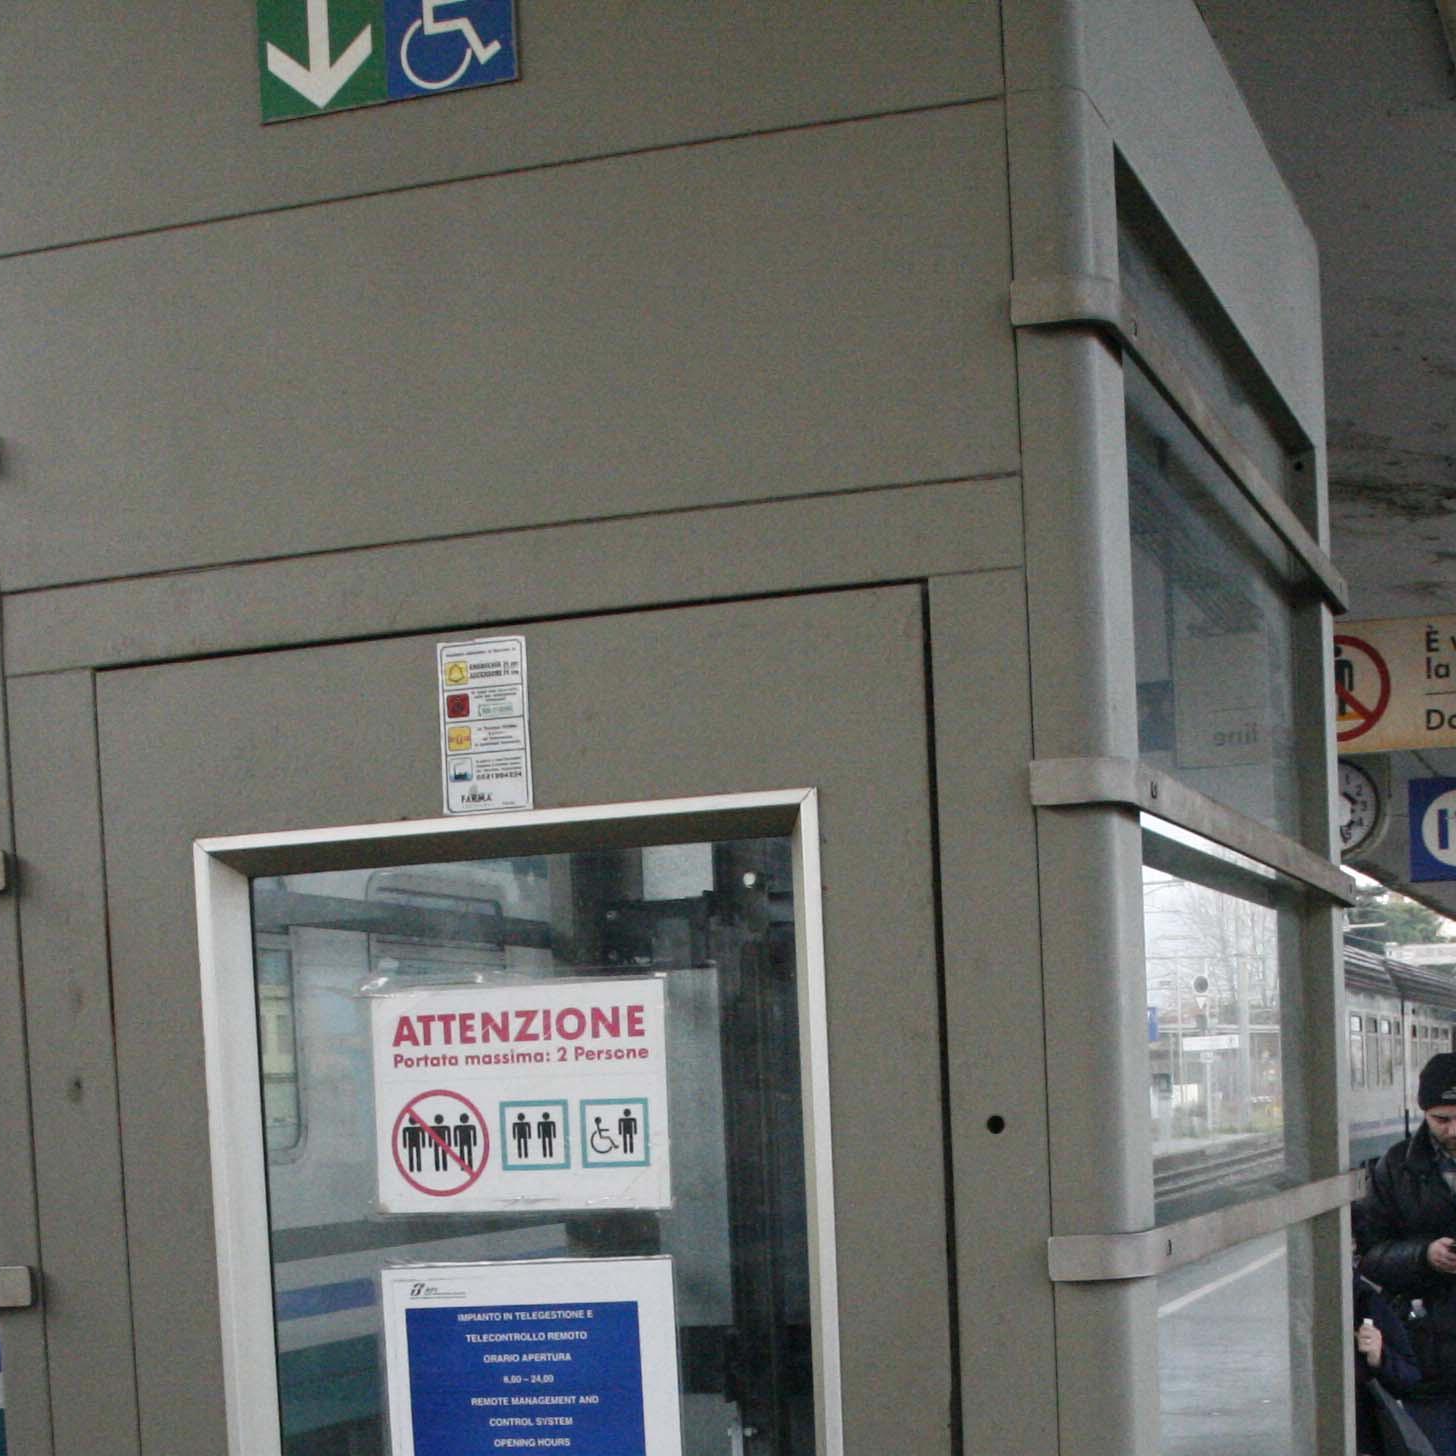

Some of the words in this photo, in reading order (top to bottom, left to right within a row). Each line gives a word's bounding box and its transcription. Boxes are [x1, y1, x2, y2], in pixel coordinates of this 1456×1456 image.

[1425, 625, 1439, 652] È
[1425, 656, 1451, 679] la
[392, 1004, 646, 1047] ATTENZIONE
[393, 1053, 459, 1069] Portata
[465, 1049, 551, 1066] massima:
[556, 1047, 567, 1062] 2
[574, 1045, 649, 1062] Persone
[457, 1312, 501, 1322] IMPIANTO
[503, 1312, 513, 1321] IN
[514, 1310, 585, 1321] TELEGESTIONE
[587, 1309, 593, 1319] E
[466, 1332, 545, 1343] TELECONTROLLO
[547, 1331, 588, 1340] REMOTO
[483, 1354, 520, 1363] ORARIO
[521, 1352, 572, 1362] APERTURA
[471, 1396, 509, 1406] REMOTE
[512, 1395, 577, 1405] MANAGEMENT
[579, 1395, 600, 1404] AND
[489, 1417, 534, 1427] CONTROL
[535, 1416, 573, 1426] SYSTEM
[494, 1438, 536, 1448] OPENING
[537, 1437, 571, 1447] HOURS
